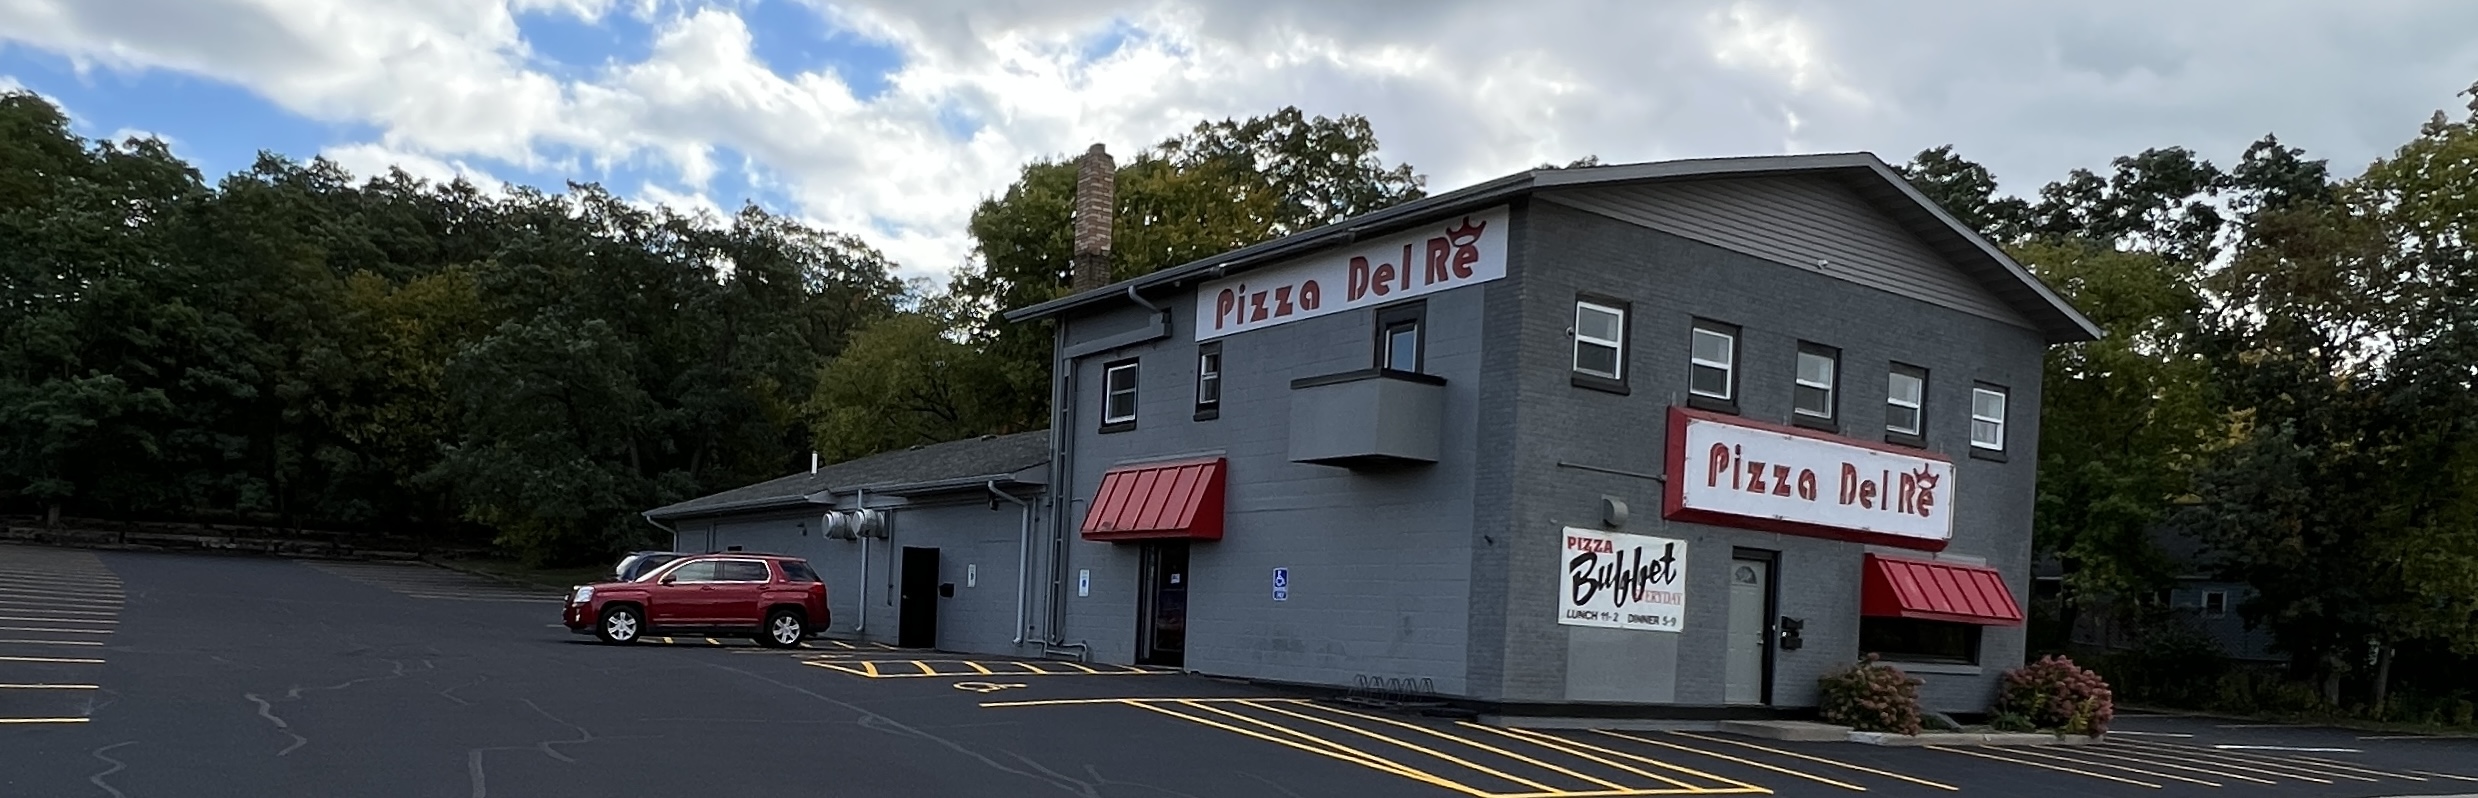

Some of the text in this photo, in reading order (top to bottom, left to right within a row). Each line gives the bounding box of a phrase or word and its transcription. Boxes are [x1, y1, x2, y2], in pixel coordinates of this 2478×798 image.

[1215, 278, 1321, 330] Pizza
[1347, 243, 1413, 302] Del
[1707, 442, 1818, 501] Pizza
[1839, 461, 1890, 511] Del
[1567, 535, 1614, 554] PIZZA
[1569, 542, 1677, 608] Buffet
[1566, 609, 1598, 620] LUNCH
[1627, 613, 1660, 625] DINNER
[1662, 615, 1677, 627] 5-9
[1634, 589, 1683, 607] ERYDAY
